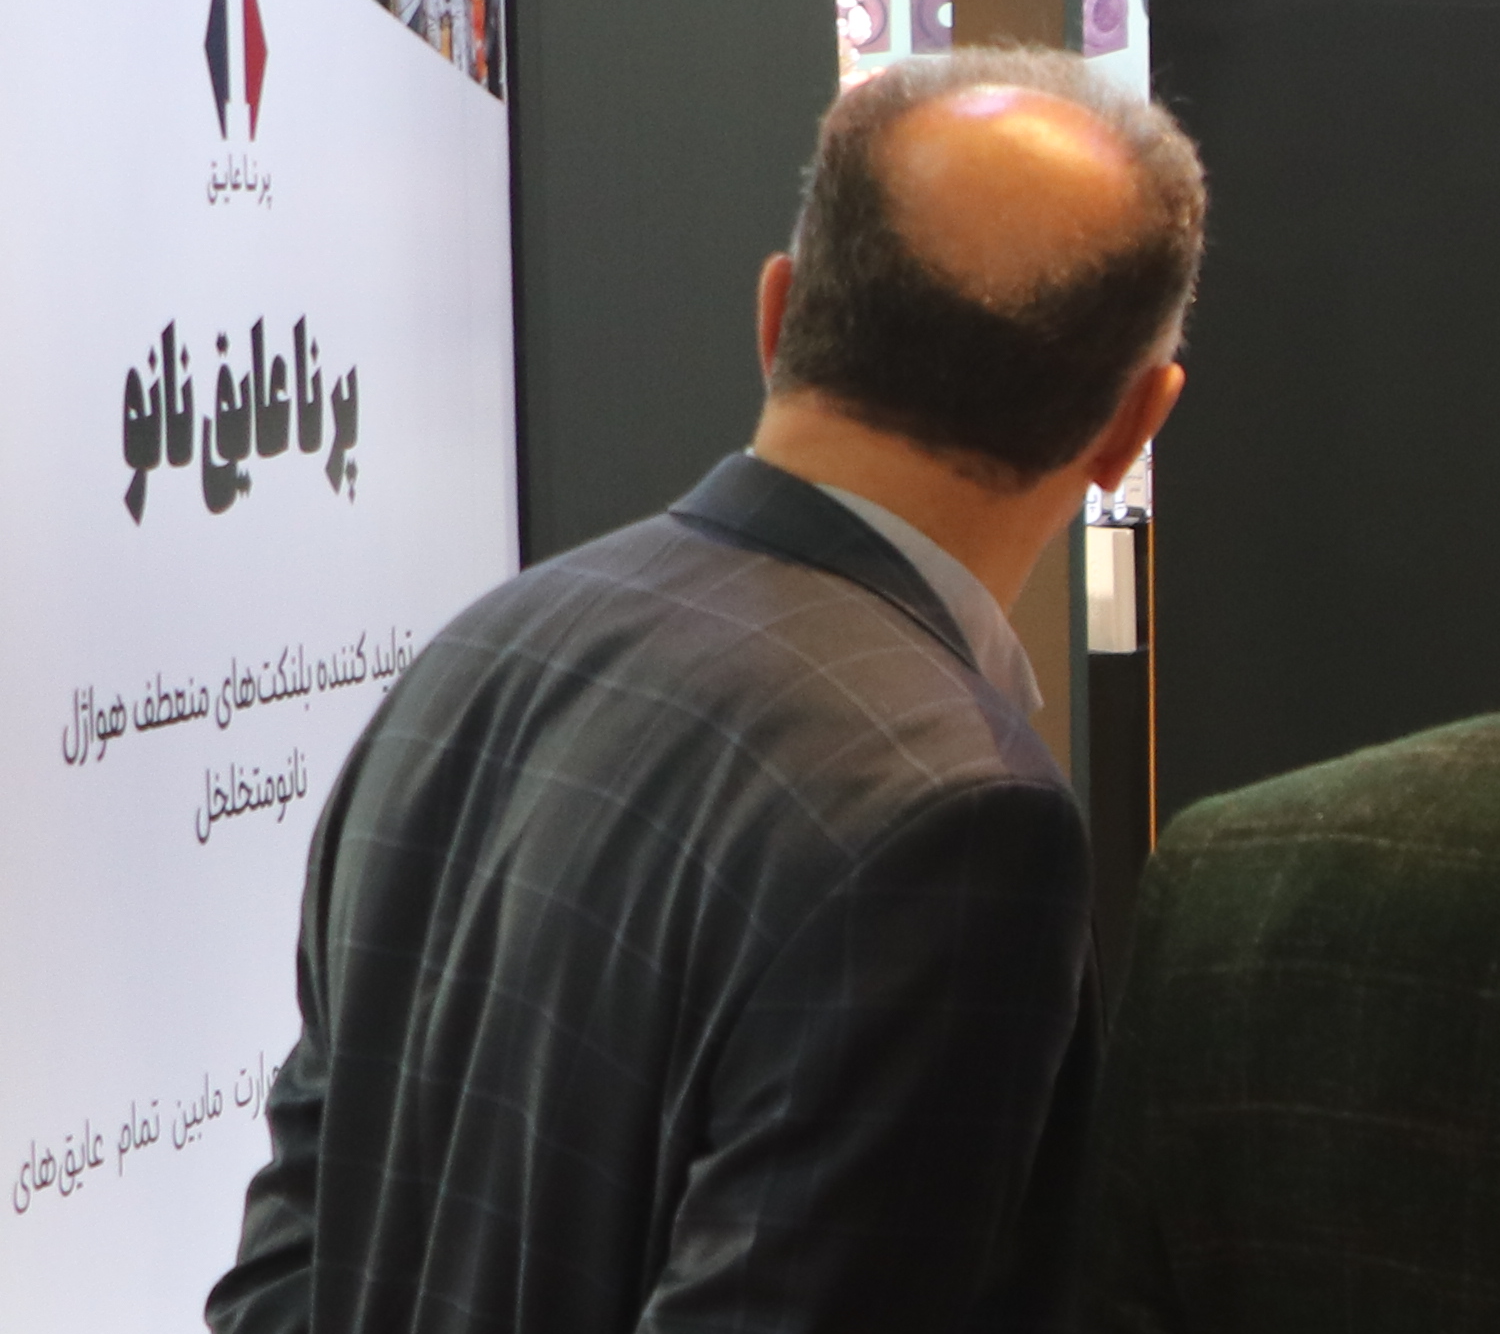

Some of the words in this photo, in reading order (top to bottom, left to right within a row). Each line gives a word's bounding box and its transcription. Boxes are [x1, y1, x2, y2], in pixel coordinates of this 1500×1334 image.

[123, 318, 195, 527] نانو
[316, 631, 367, 693] کننده
[134, 670, 209, 732] منعطف
[118, 1100, 160, 1178] تمام
